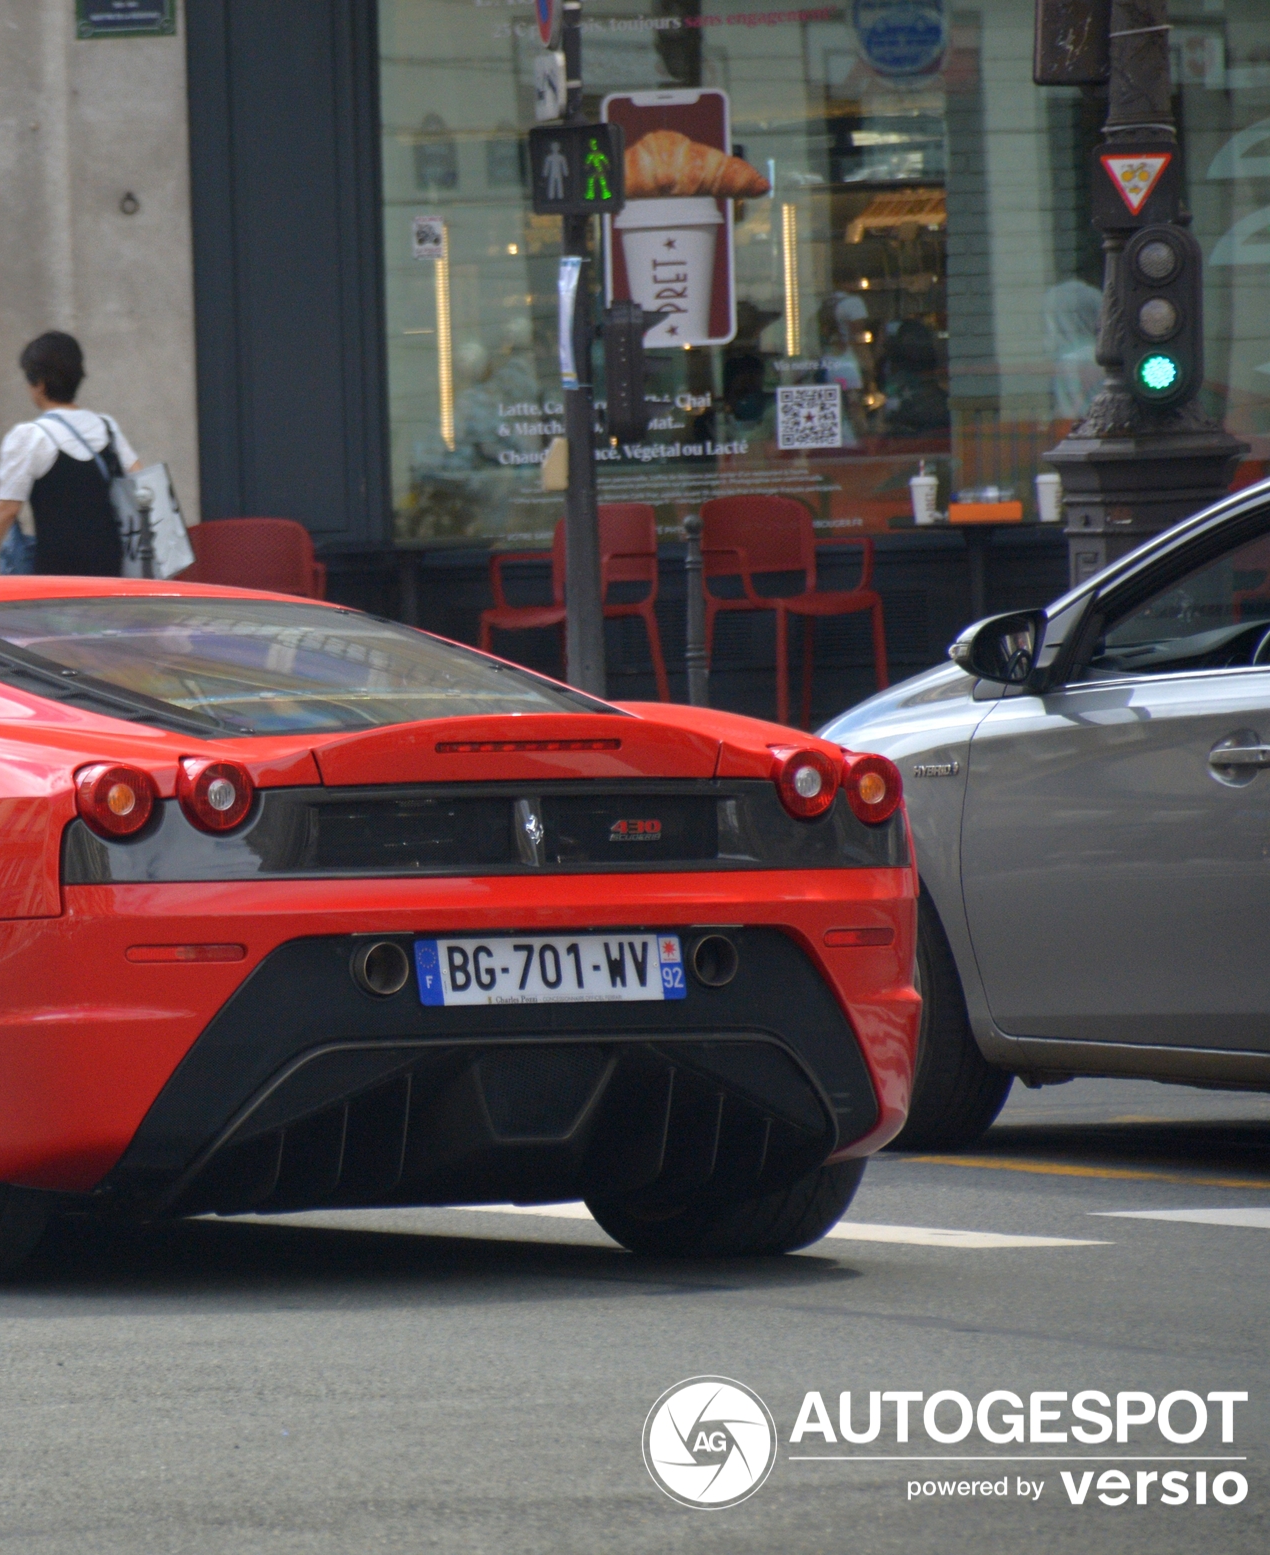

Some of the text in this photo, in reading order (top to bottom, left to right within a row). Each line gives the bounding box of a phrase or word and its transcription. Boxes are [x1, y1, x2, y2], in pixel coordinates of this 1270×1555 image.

[609, 15, 681, 32] toujours
[684, 16, 722, 28] sans
[652, 259, 688, 314] PRET
[674, 392, 712, 408] Chai
[497, 423, 512, 437] &
[622, 441, 680, 463] Végétal
[682, 445, 702, 456] ou
[706, 439, 749, 456] Lacté
[913, 764, 952, 778] HYBRID
[610, 819, 662, 834] 430
[425, 941, 684, 993] F BG-701-WV 92
